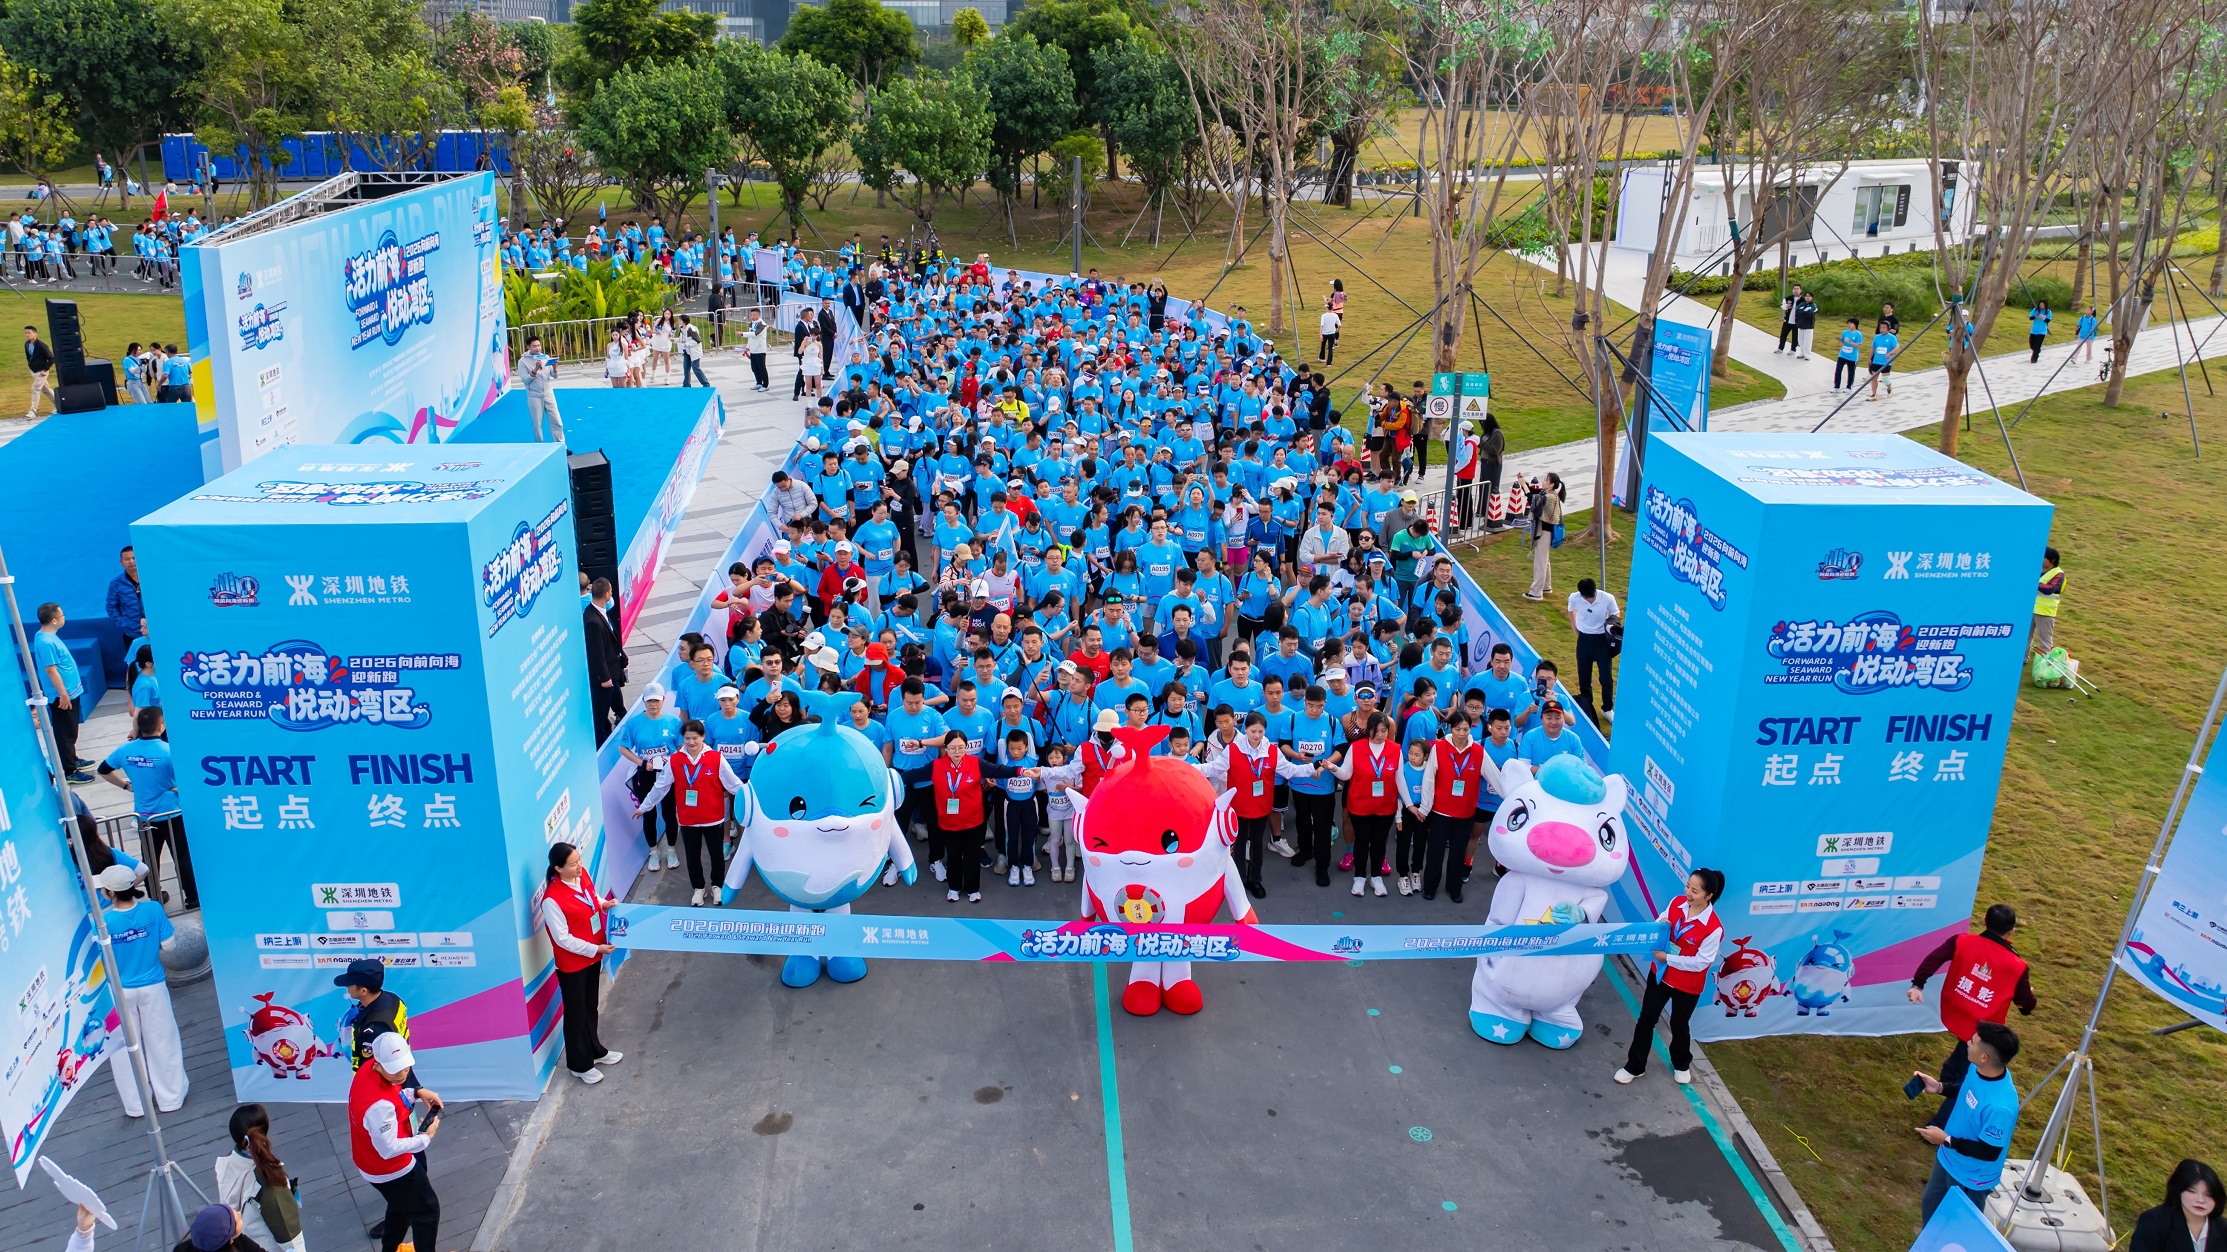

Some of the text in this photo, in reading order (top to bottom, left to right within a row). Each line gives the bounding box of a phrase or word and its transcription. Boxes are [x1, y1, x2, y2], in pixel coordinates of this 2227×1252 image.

[351, 244, 400, 302] 活力前海
[355, 302, 375, 318] FORWARD
[386, 277, 430, 333] 悦动湾区
[360, 312, 379, 329] SEAWARD
[351, 324, 381, 347] NEW YEAR RUN
[1650, 488, 1697, 544] 活力前海
[1703, 530, 1748, 568] 2026向前向海
[488, 532, 532, 596] 活力前海
[1916, 552, 1992, 570] 深圳地铁
[520, 542, 559, 608] 悦动湾区
[1674, 538, 1723, 602] 悦动湾区
[321, 575, 410, 595] 深圳地铁
[378, 596, 412, 604] METRO
[1782, 622, 1900, 652] 活力前海
[1918, 626, 2012, 637] 2026向前向海
[1915, 639, 1956, 651] 迎新跑
[198, 652, 328, 686] 活力前海
[350, 656, 460, 668] 2026向前向海
[1790, 666, 1832, 674] SEAWARD
[1851, 654, 1964, 686] 悦动湾区
[351, 671, 398, 684] 迎新跑
[1812, 674, 1833, 682] RUN
[204, 691, 253, 699] FORWARD
[216, 700, 263, 708] SEAWARD
[287, 688, 415, 722] 悦动湾区
[192, 709, 266, 718] NEW YEAR RUN
[1756, 714, 1992, 746] START FINISH
[642, 746, 666, 755] A0143
[719, 746, 742, 754] A0141
[966, 740, 982, 749] 0172
[1300, 742, 1323, 750] A0270
[200, 753, 474, 787] START FINISH
[1761, 750, 1969, 787] 起点 终点
[1008, 778, 1030, 786] A0230
[222, 792, 462, 830] 起点 终点
[1841, 836, 1886, 847] 深圳地铁
[341, 887, 392, 898] 深圳地铁
[1758, 884, 1794, 894] 纳兰上游
[1813, 900, 1840, 908] nailong
[670, 918, 826, 936] 2026向前向海迎新跑
[882, 928, 930, 940] 深圳地铁
[264, 936, 302, 946] 纳兰上游
[1033, 930, 1230, 958] 活力前海 悦动湾区
[1404, 936, 1560, 948] 2026向前向海迎新跑
[1614, 932, 1660, 943] 深圳地铁
[1957, 976, 1994, 1002] 摄影
[1954, 988, 1988, 1008] PHOTOGRAPHER
